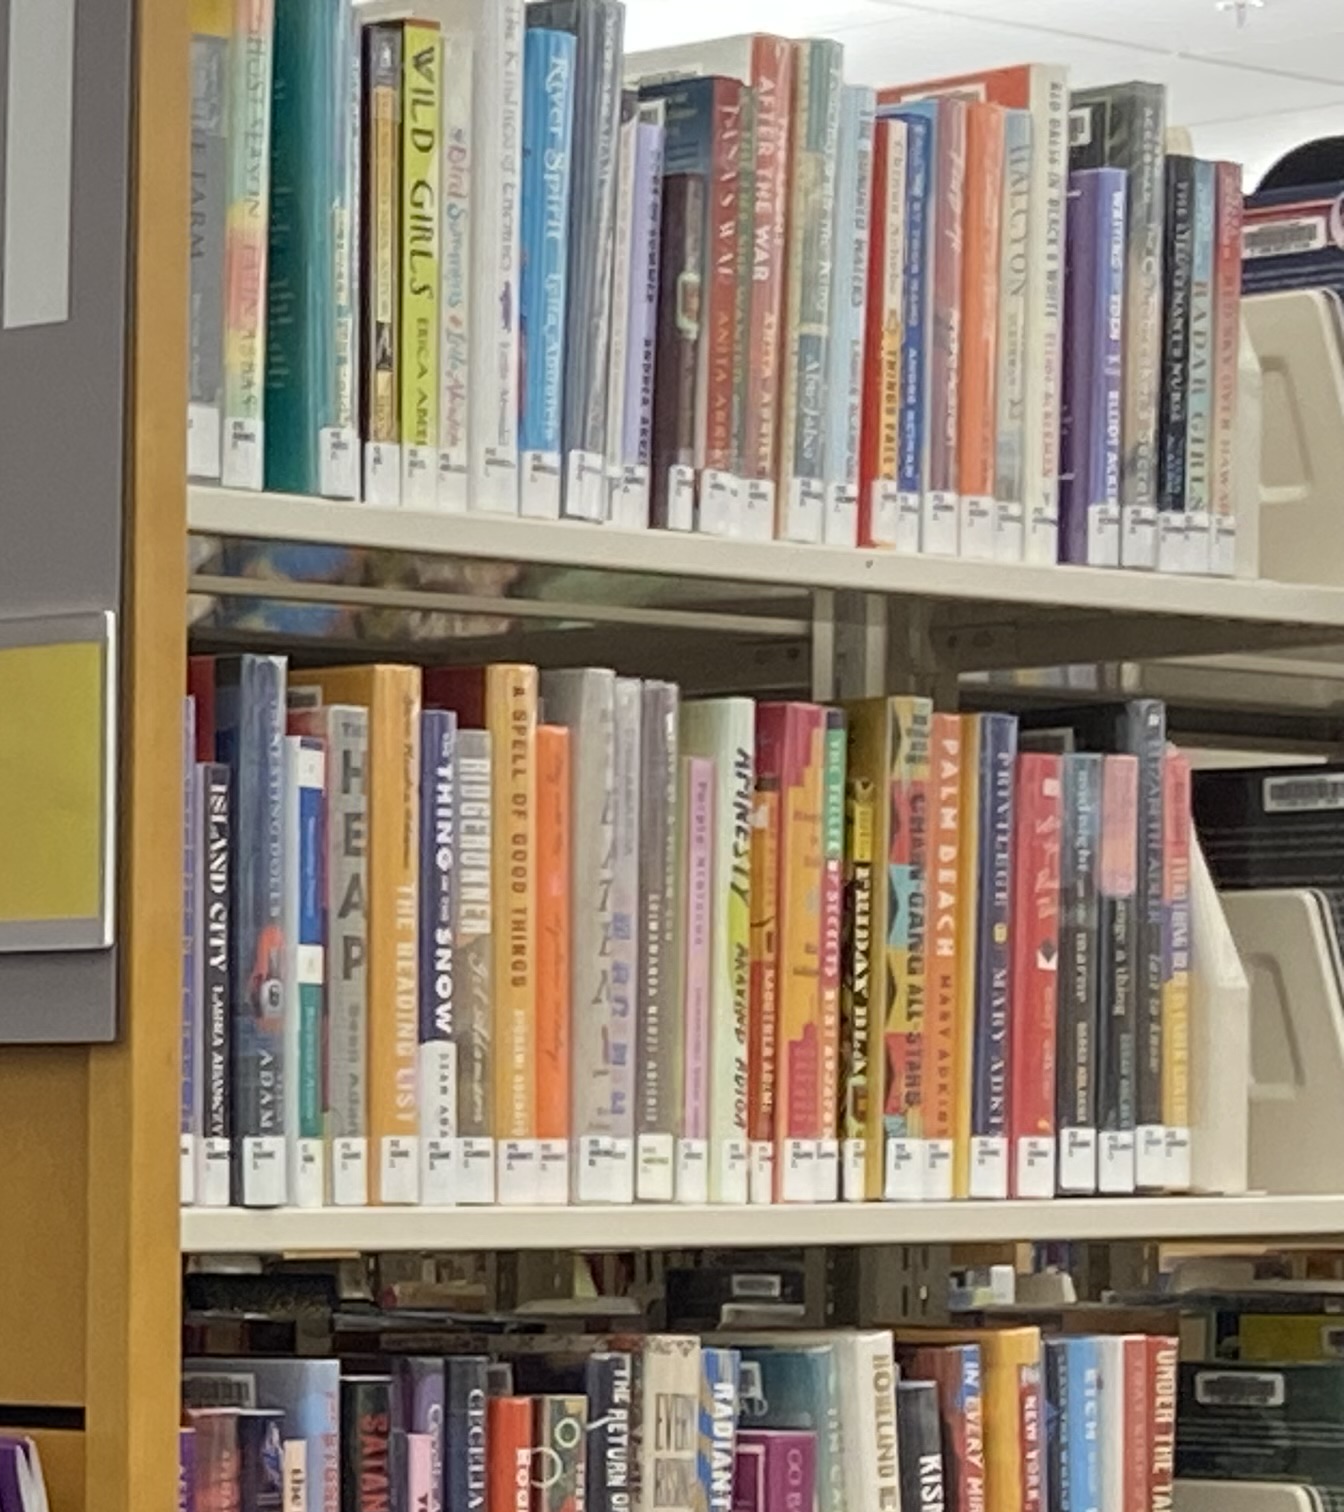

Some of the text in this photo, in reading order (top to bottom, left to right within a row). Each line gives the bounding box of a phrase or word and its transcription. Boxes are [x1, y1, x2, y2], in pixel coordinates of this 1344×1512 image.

[408, 45, 435, 301] WILD GIRLS
[545, 55, 569, 241] River Spirit
[752, 76, 775, 281] AFTER THE WAR
[1007, 145, 1029, 299] HALCYON
[1188, 280, 1209, 513] RADAR GIRLS
[209, 783, 228, 974] ISLAND CITY
[338, 749, 366, 982] HEAP
[434, 762, 454, 1034] THING SNOW
[458, 756, 491, 934] RIDGERUNNER
[511, 709, 528, 989] SPELL OF GOOD THINGS
[732, 747, 751, 907] AMNESTY
[936, 738, 957, 1037] PALM BEACH MARY
[990, 751, 1011, 1043] PRIVILEGE MARY
[396, 883, 417, 1122] THE READING LIST
[852, 866, 873, 998] FRIDAY
[1112, 967, 1130, 1017] thing
[466, 1388, 486, 1510] CECELIA
[606, 1408, 628, 1487] RETURN
[613, 1367, 631, 1404] THE
[712, 1382, 734, 1511] RADIANT
[964, 1362, 978, 1387] IN
[965, 1396, 982, 1469] EVERY
[1024, 1396, 1038, 1444] NEW
[1155, 1350, 1173, 1424] UNDER
[289, 1468, 304, 1506] the
[786, 1448, 804, 1486] GO
[1152, 1432, 1173, 1474] THE
